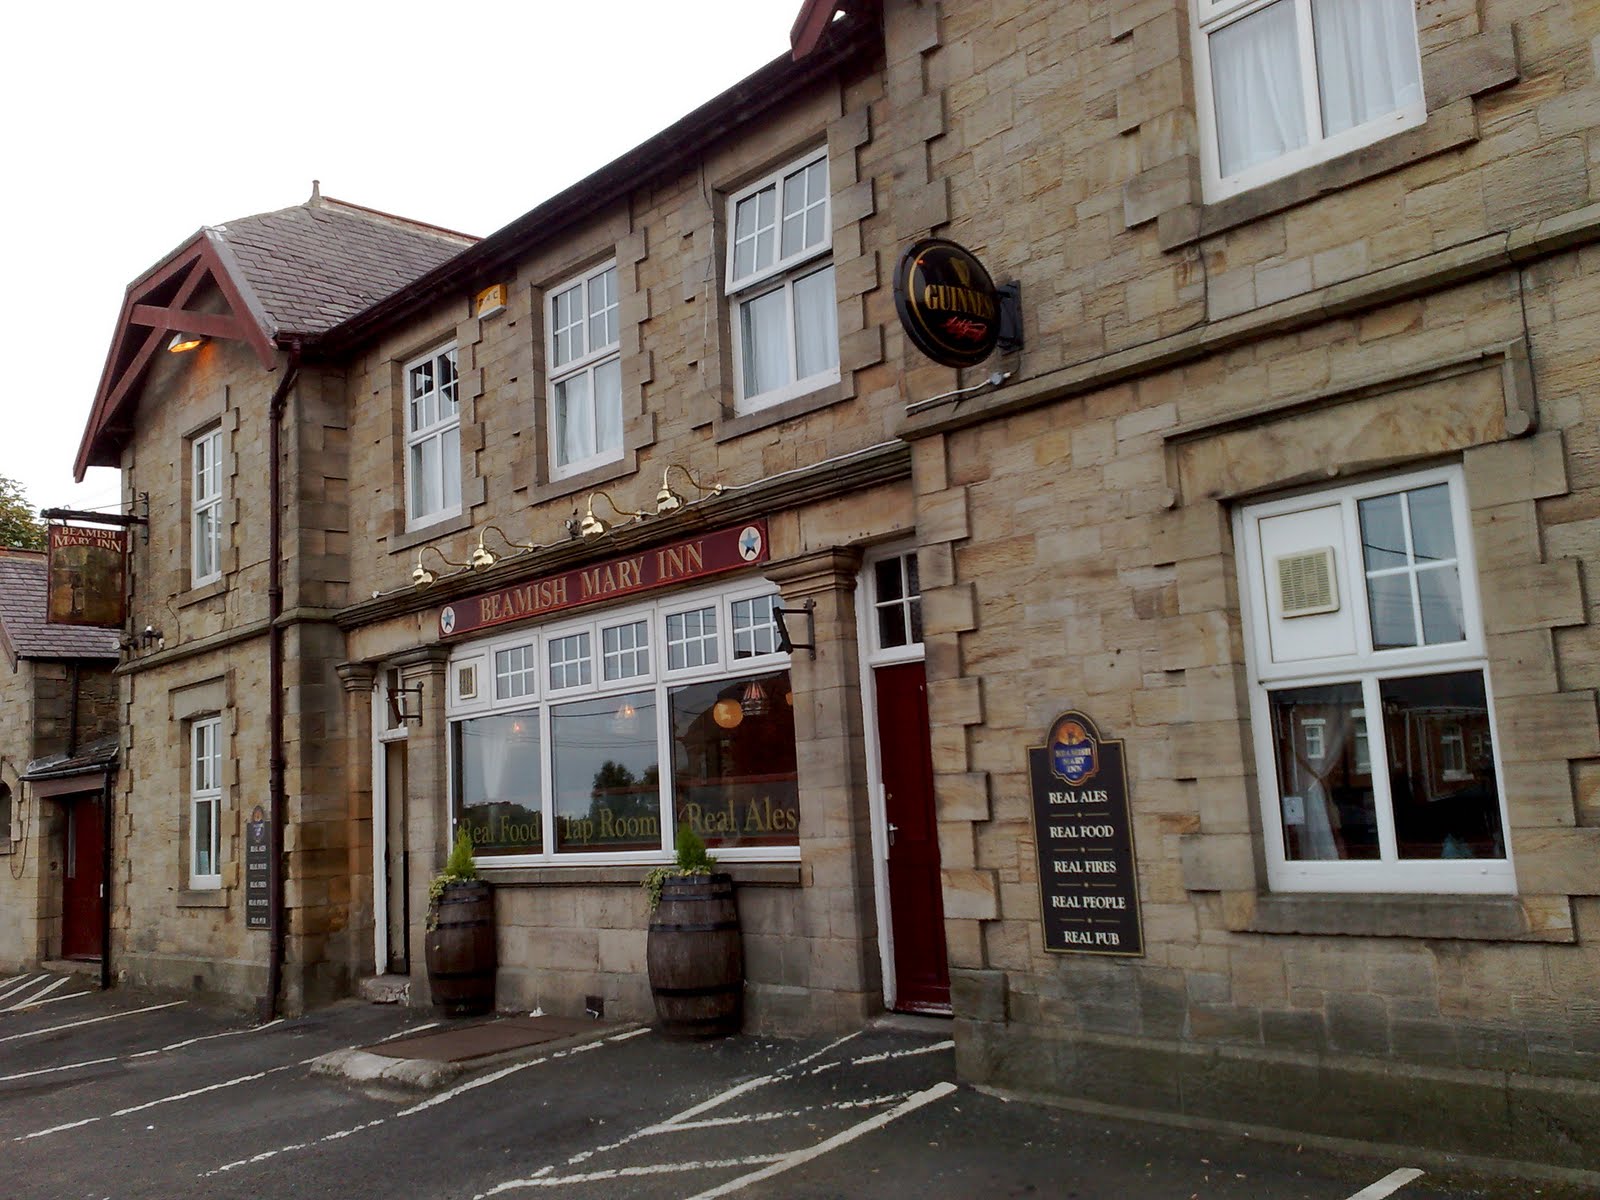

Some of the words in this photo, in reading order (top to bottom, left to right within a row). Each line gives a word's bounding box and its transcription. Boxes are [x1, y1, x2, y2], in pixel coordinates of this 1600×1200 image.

[62, 527, 116, 540] BEAMISH
[54, 535, 92, 548] MARY
[97, 538, 122, 553] INN
[480, 577, 568, 622] BEAMISH
[581, 556, 644, 599] MARY
[657, 541, 704, 580] INN
[1048, 791, 1078, 804] REAL
[1080, 790, 1108, 803] ALES
[686, 799, 738, 833] Real
[743, 795, 797, 831] Ales
[500, 813, 541, 842] Food
[599, 808, 658, 837] Room
[1049, 826, 1079, 838] REAL
[1080, 825, 1115, 838] FOOD
[1053, 861, 1083, 873] REAL
[1084, 861, 1117, 873] FIRES
[1051, 895, 1081, 908] REAL
[1082, 896, 1127, 909] PEOPLE
[1064, 931, 1094, 944] REAL
[1095, 932, 1120, 945] PUB
